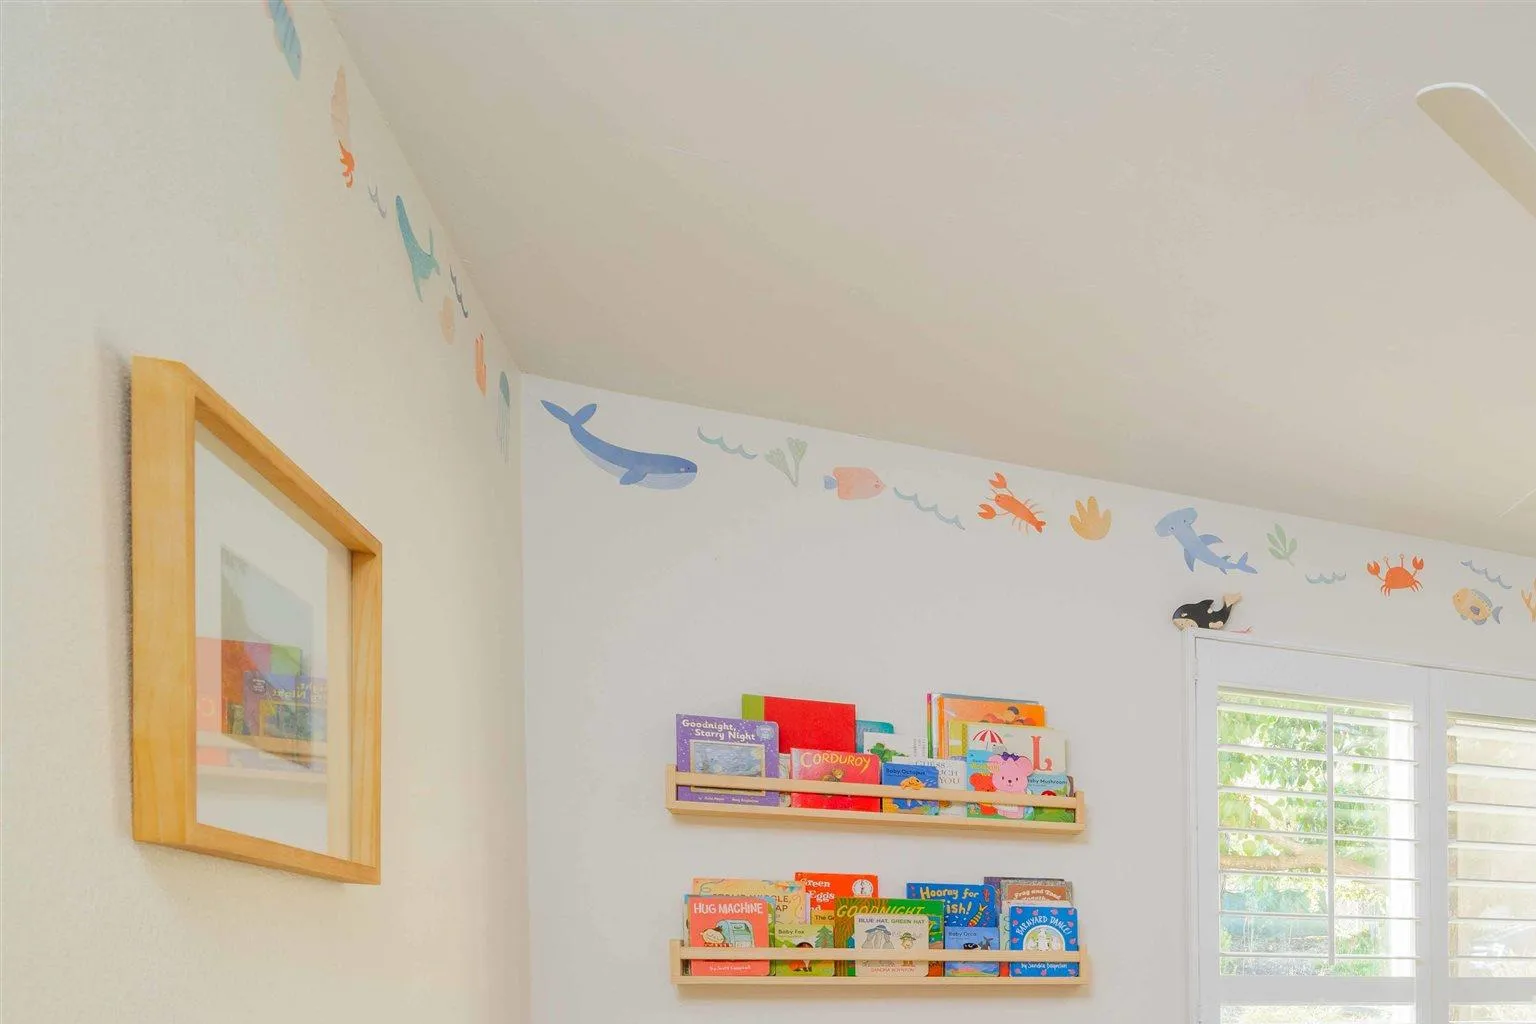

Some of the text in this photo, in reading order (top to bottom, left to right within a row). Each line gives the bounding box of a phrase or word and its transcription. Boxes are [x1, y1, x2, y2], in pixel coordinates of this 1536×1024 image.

[682, 719, 737, 732] Goodnight,
[694, 728, 725, 740] Starry
[728, 731, 756, 742] Night
[800, 752, 871, 774] CORDUROY
[800, 878, 831, 888] Green
[809, 890, 835, 902] Eggs
[920, 886, 979, 900] Hooray for
[1014, 890, 1030, 899] Frog
[694, 902, 764, 914] HUG MACHINE
[837, 905, 925, 918] GOODNIGHT
[946, 901, 972, 915] ish!
[1015, 916, 1072, 935] BARNYARD DANCE!
